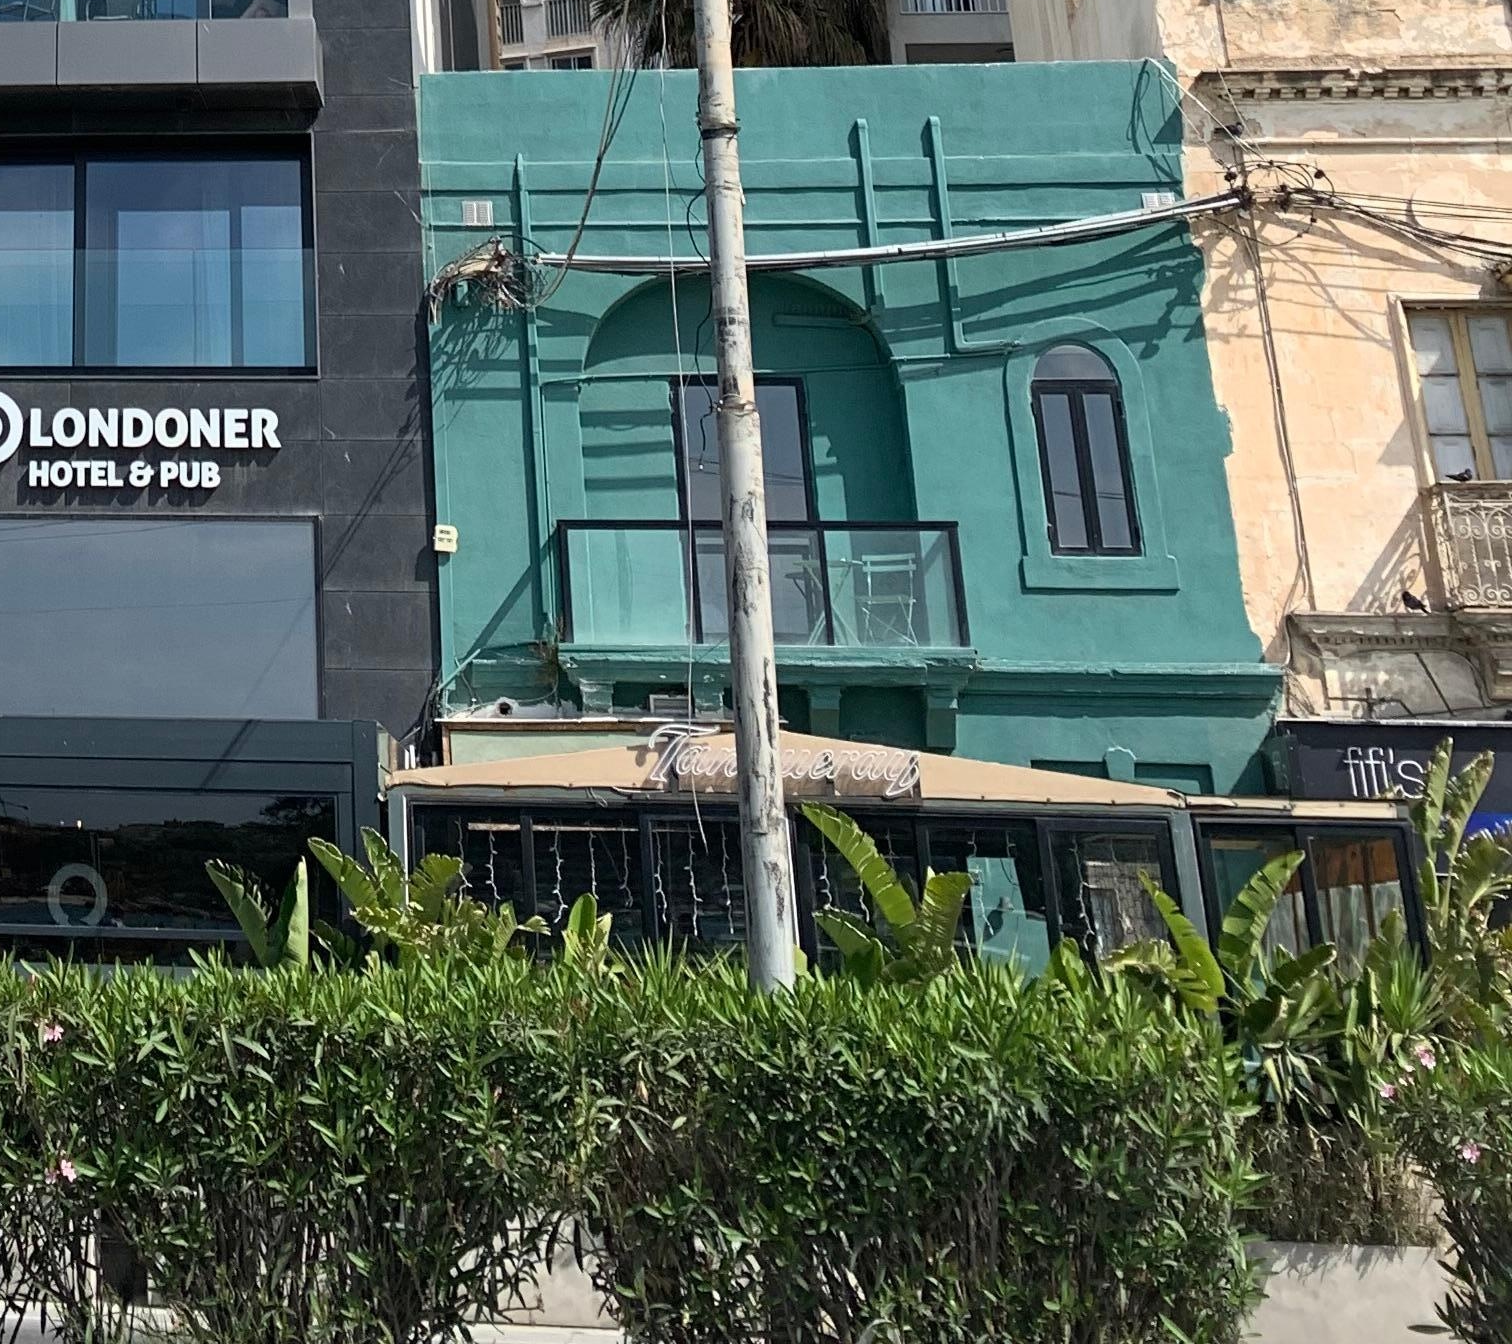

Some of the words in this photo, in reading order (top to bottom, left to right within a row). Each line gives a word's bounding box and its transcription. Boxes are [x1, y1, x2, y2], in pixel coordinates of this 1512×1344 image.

[29, 407, 282, 449] LONDONER
[28, 460, 124, 488] HOTEL
[128, 461, 155, 487] &
[160, 461, 221, 489] PUB
[649, 723, 921, 798] Tanueray
